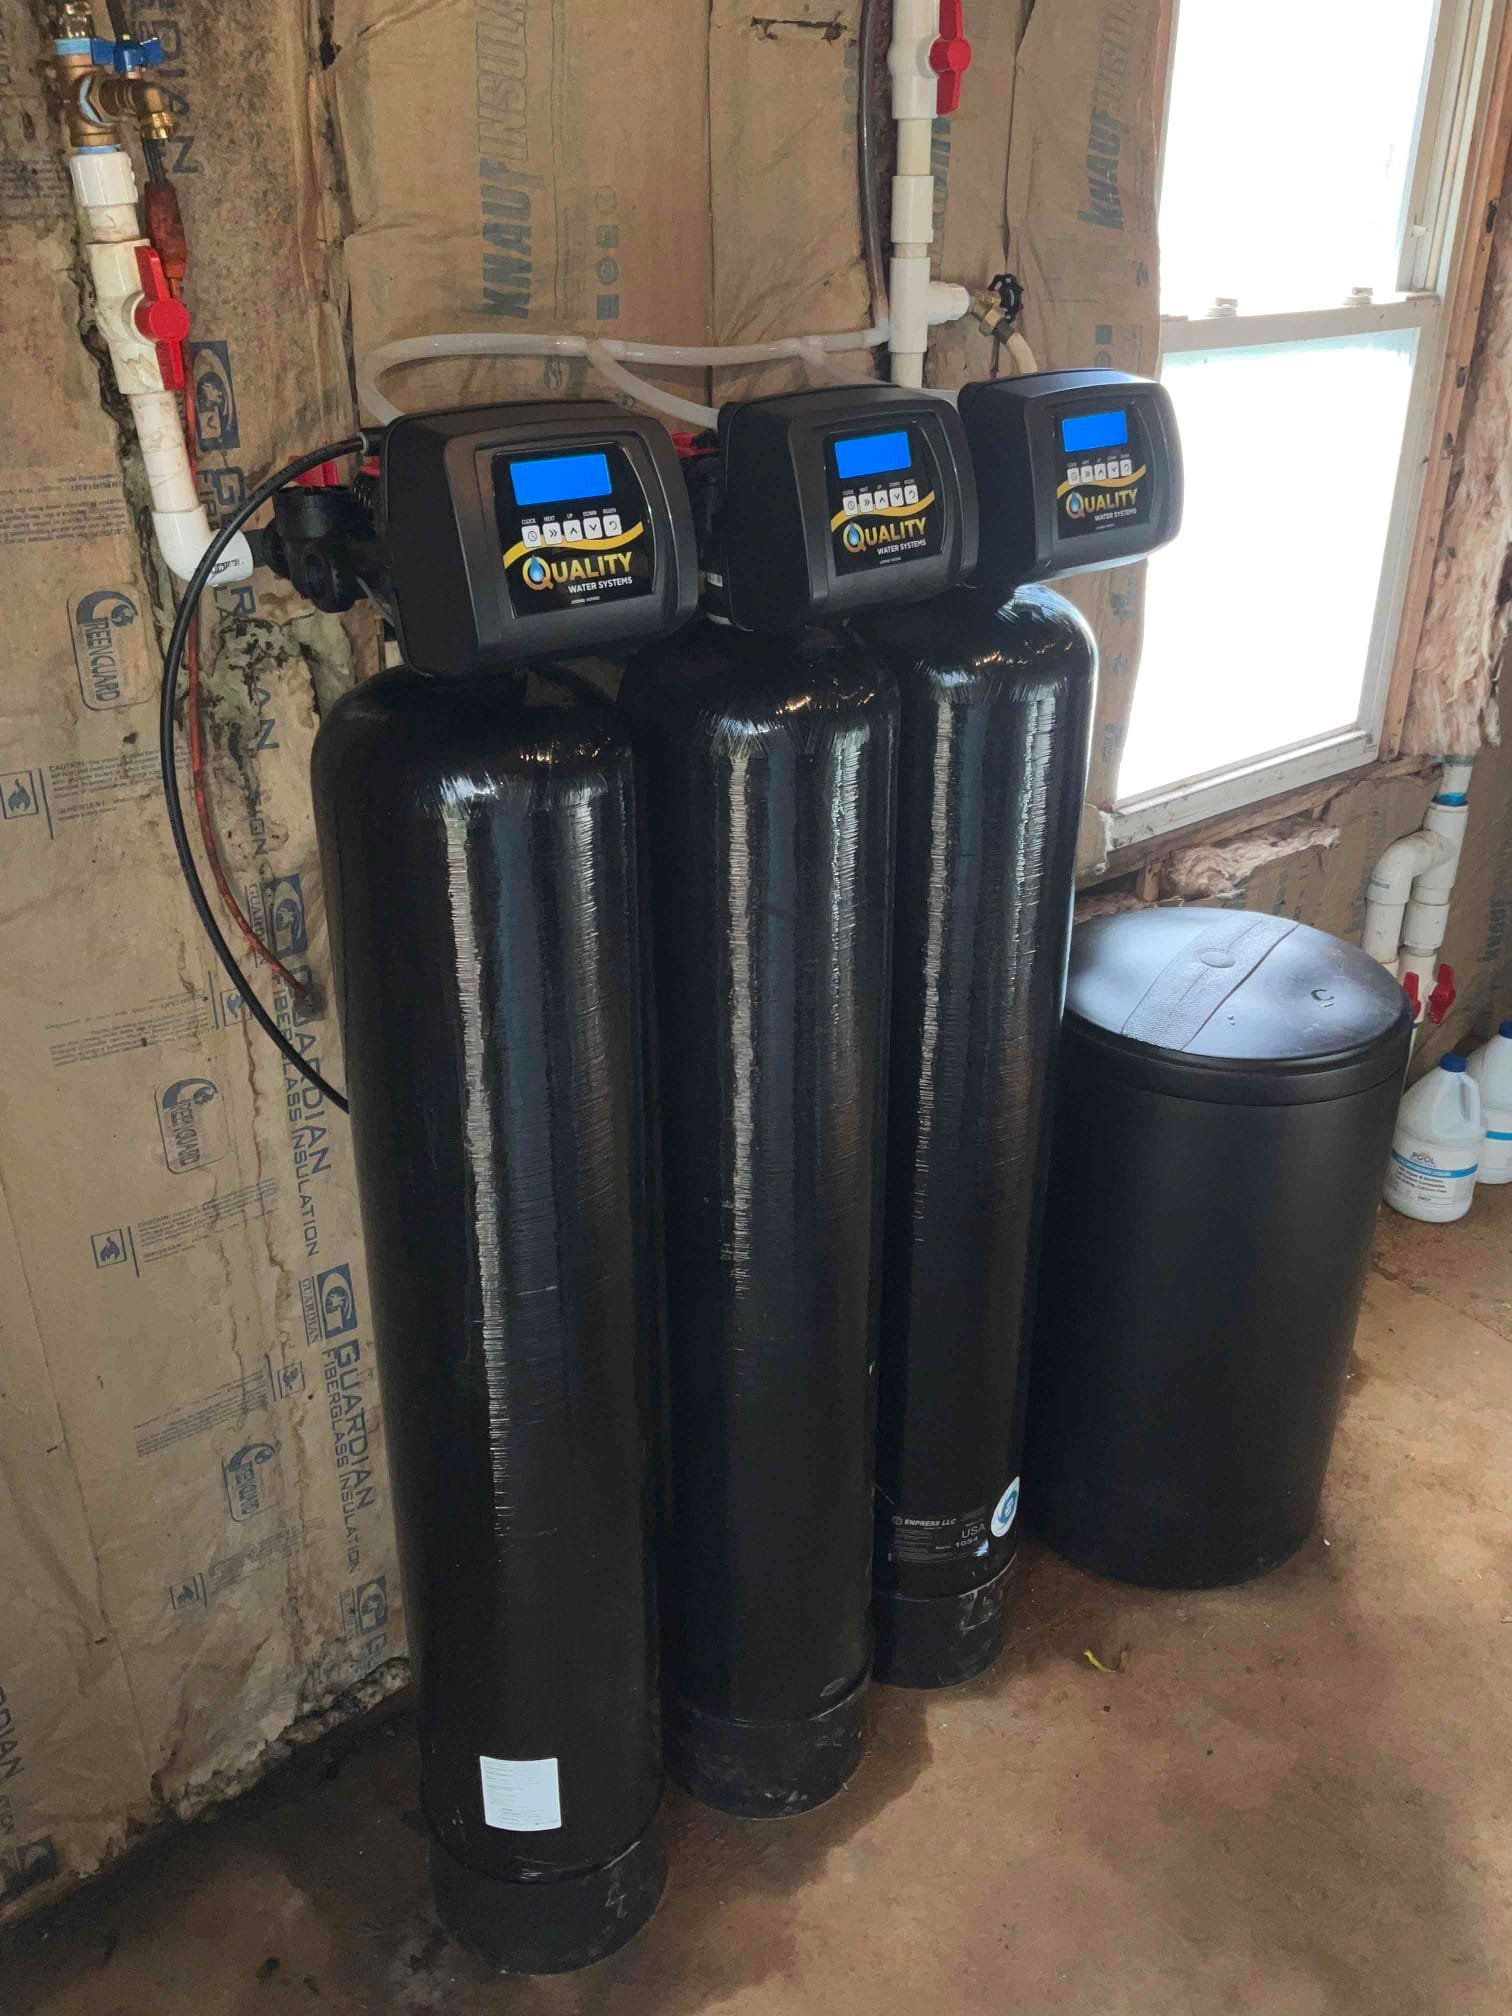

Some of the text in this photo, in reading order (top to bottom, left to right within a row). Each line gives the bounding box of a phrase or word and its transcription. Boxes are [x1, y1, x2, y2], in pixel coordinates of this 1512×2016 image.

[478, 156, 544, 320] KNAUF
[1065, 488, 1138, 519] QUALITY
[842, 516, 927, 553] QUALITY
[877, 539, 927, 556] WATER SYSTEMS
[522, 551, 633, 592] QUALITY
[567, 576, 633, 594] WATER SYSTEMS
[290, 1128, 320, 1258] INSULATION
[300, 1277, 320, 1344] GUARDIAN
[336, 1339, 375, 1510] GUARDIAN
[321, 1348, 350, 1468] FIBERGLASS
[339, 1471, 362, 1574] INSULATION
[941, 1517, 957, 1527] LLC
[960, 1522, 986, 1540] USA
